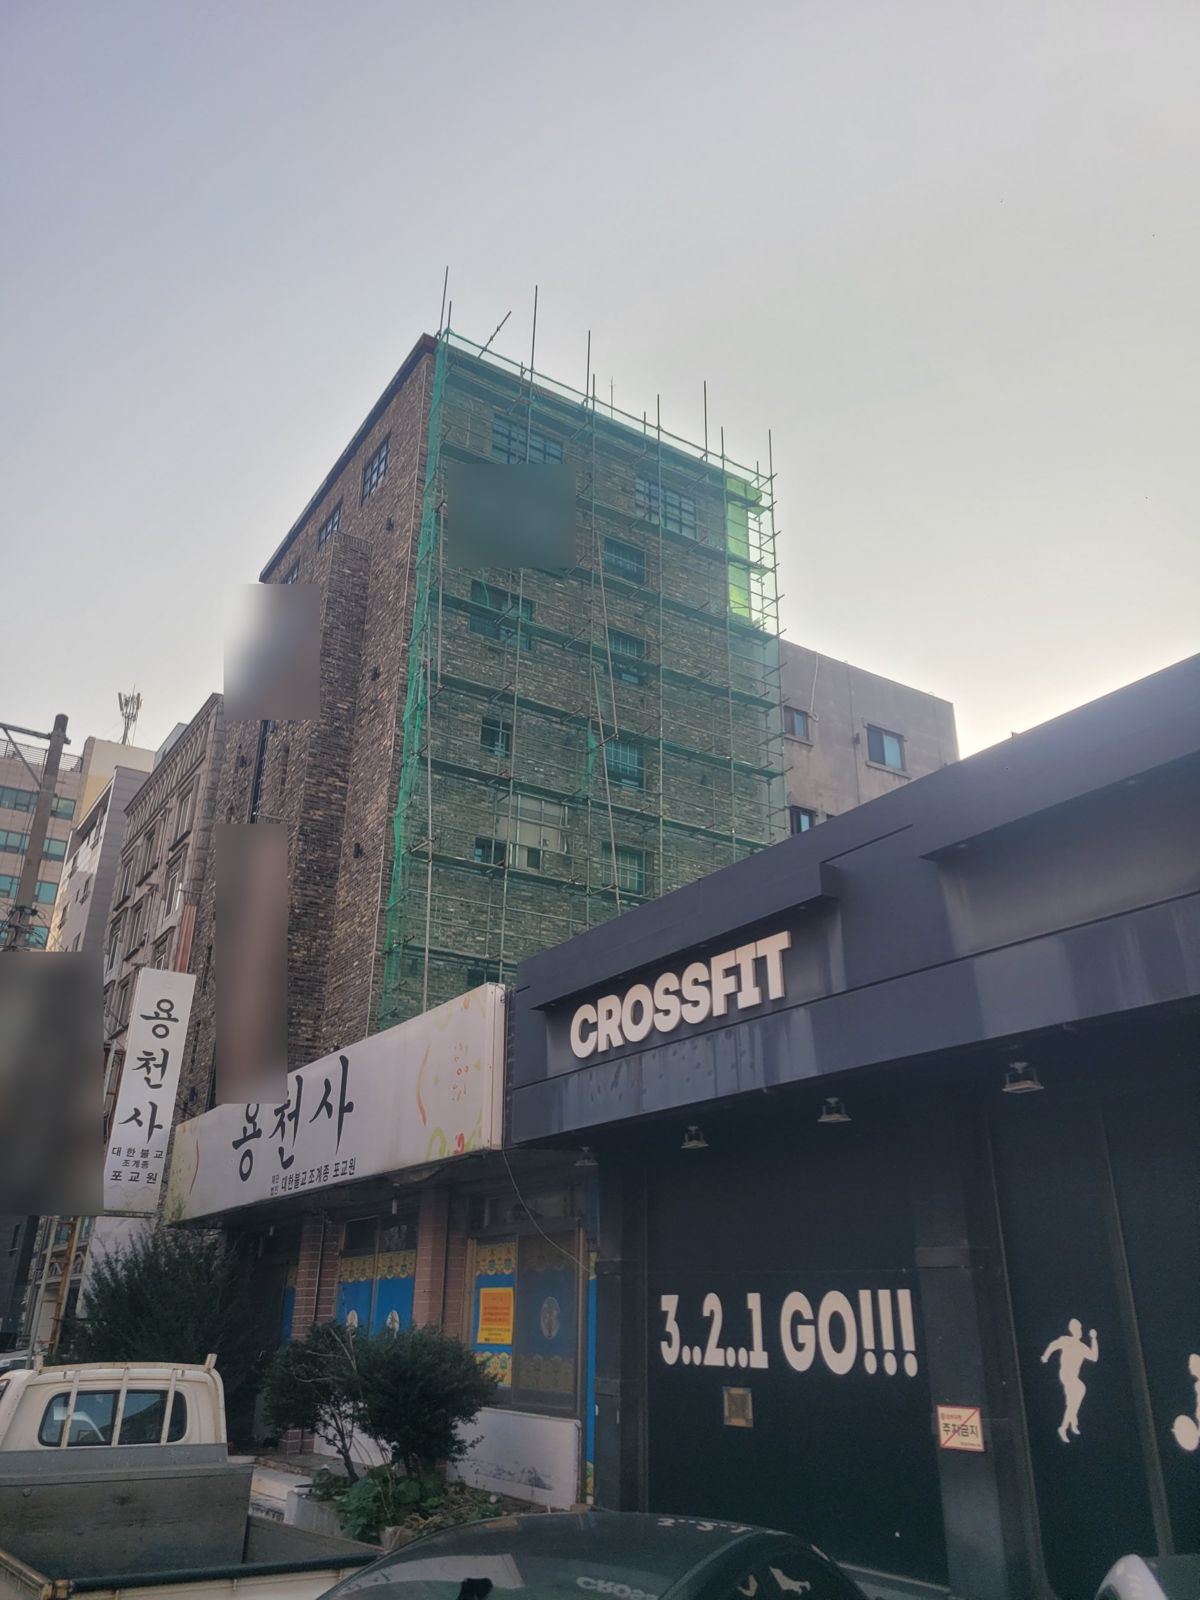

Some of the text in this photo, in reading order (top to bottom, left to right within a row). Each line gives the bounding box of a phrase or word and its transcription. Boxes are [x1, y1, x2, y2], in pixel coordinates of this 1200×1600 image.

[570, 931, 791, 1058] CROSSFIT
[118, 998, 179, 1145] 용천사
[110, 1170, 157, 1184] 포교원
[111, 1147, 163, 1158] 대한불교
[333, 1157, 356, 1178] 포교원
[780, 1289, 918, 1378] GO!!!
